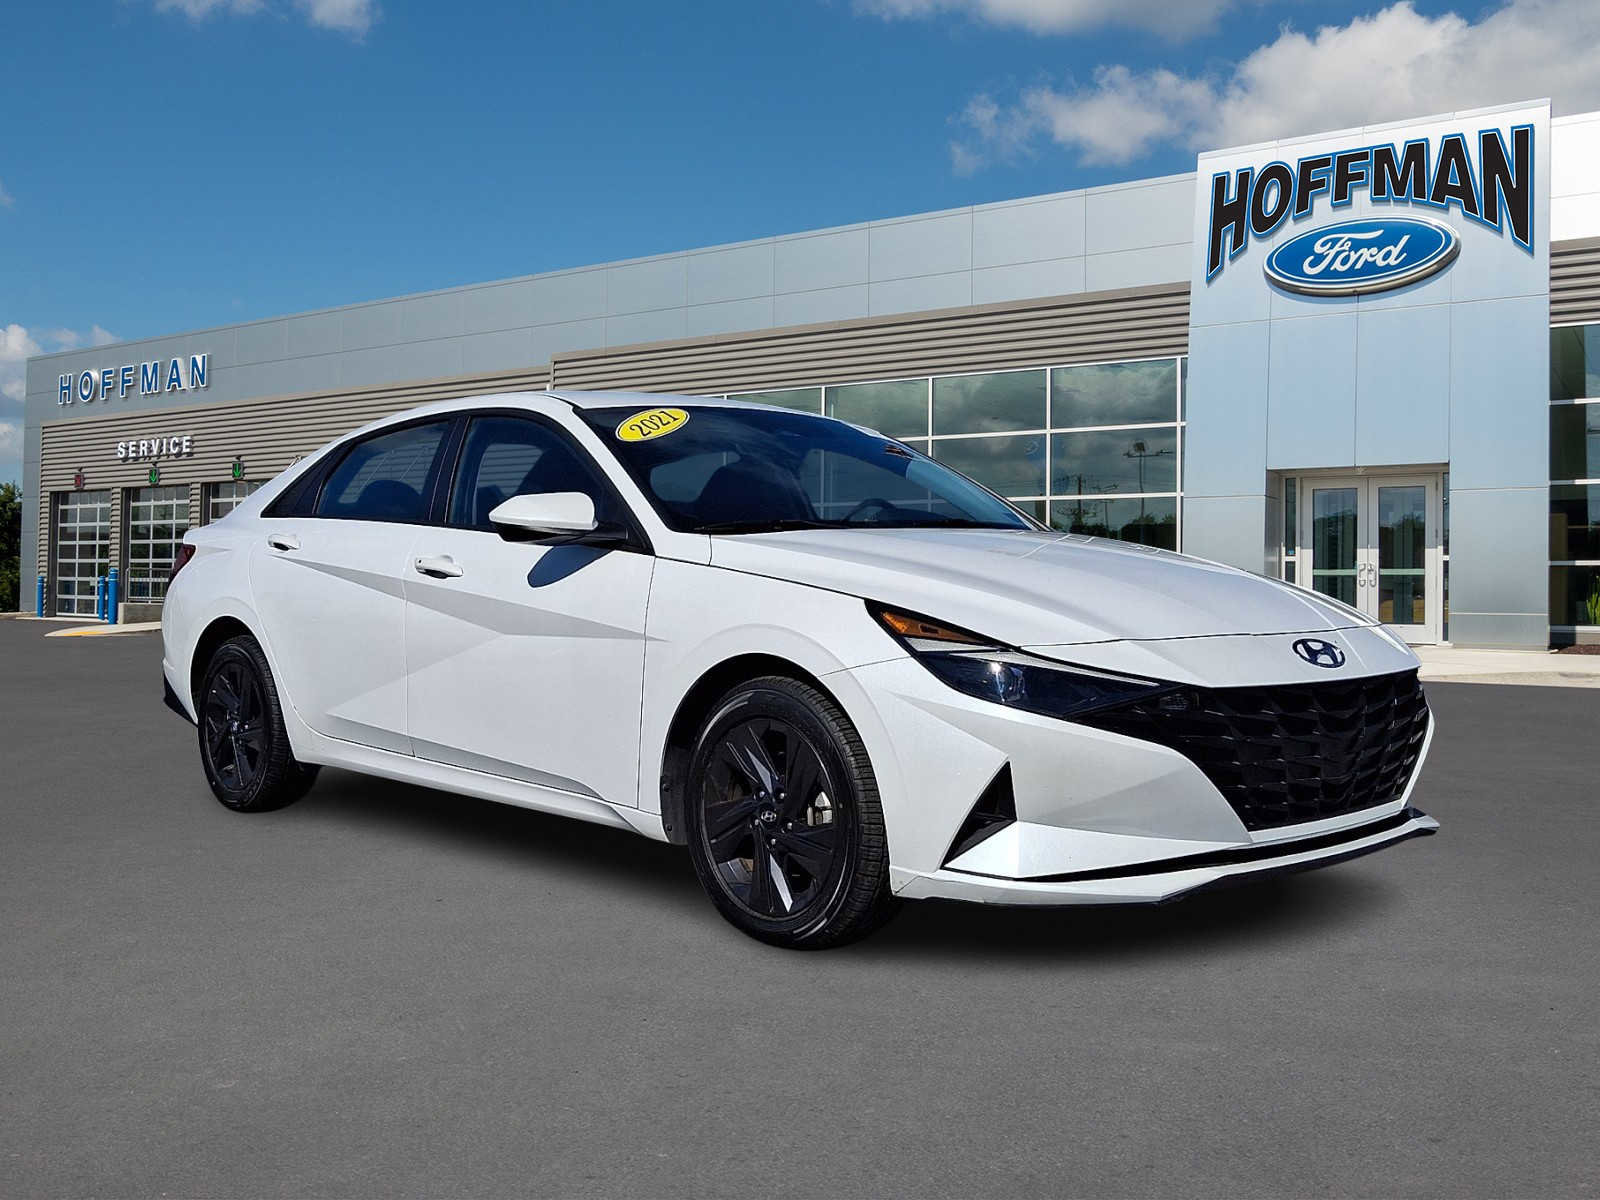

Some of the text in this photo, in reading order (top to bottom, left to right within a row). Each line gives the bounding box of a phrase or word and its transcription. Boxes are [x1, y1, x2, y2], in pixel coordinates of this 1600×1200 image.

[1206, 123, 1535, 283] HOFFMAN
[1303, 229, 1411, 275] Ford
[58, 353, 208, 405] HOFFMAN
[629, 410, 680, 437] 2021
[117, 435, 192, 459] SERVICE
